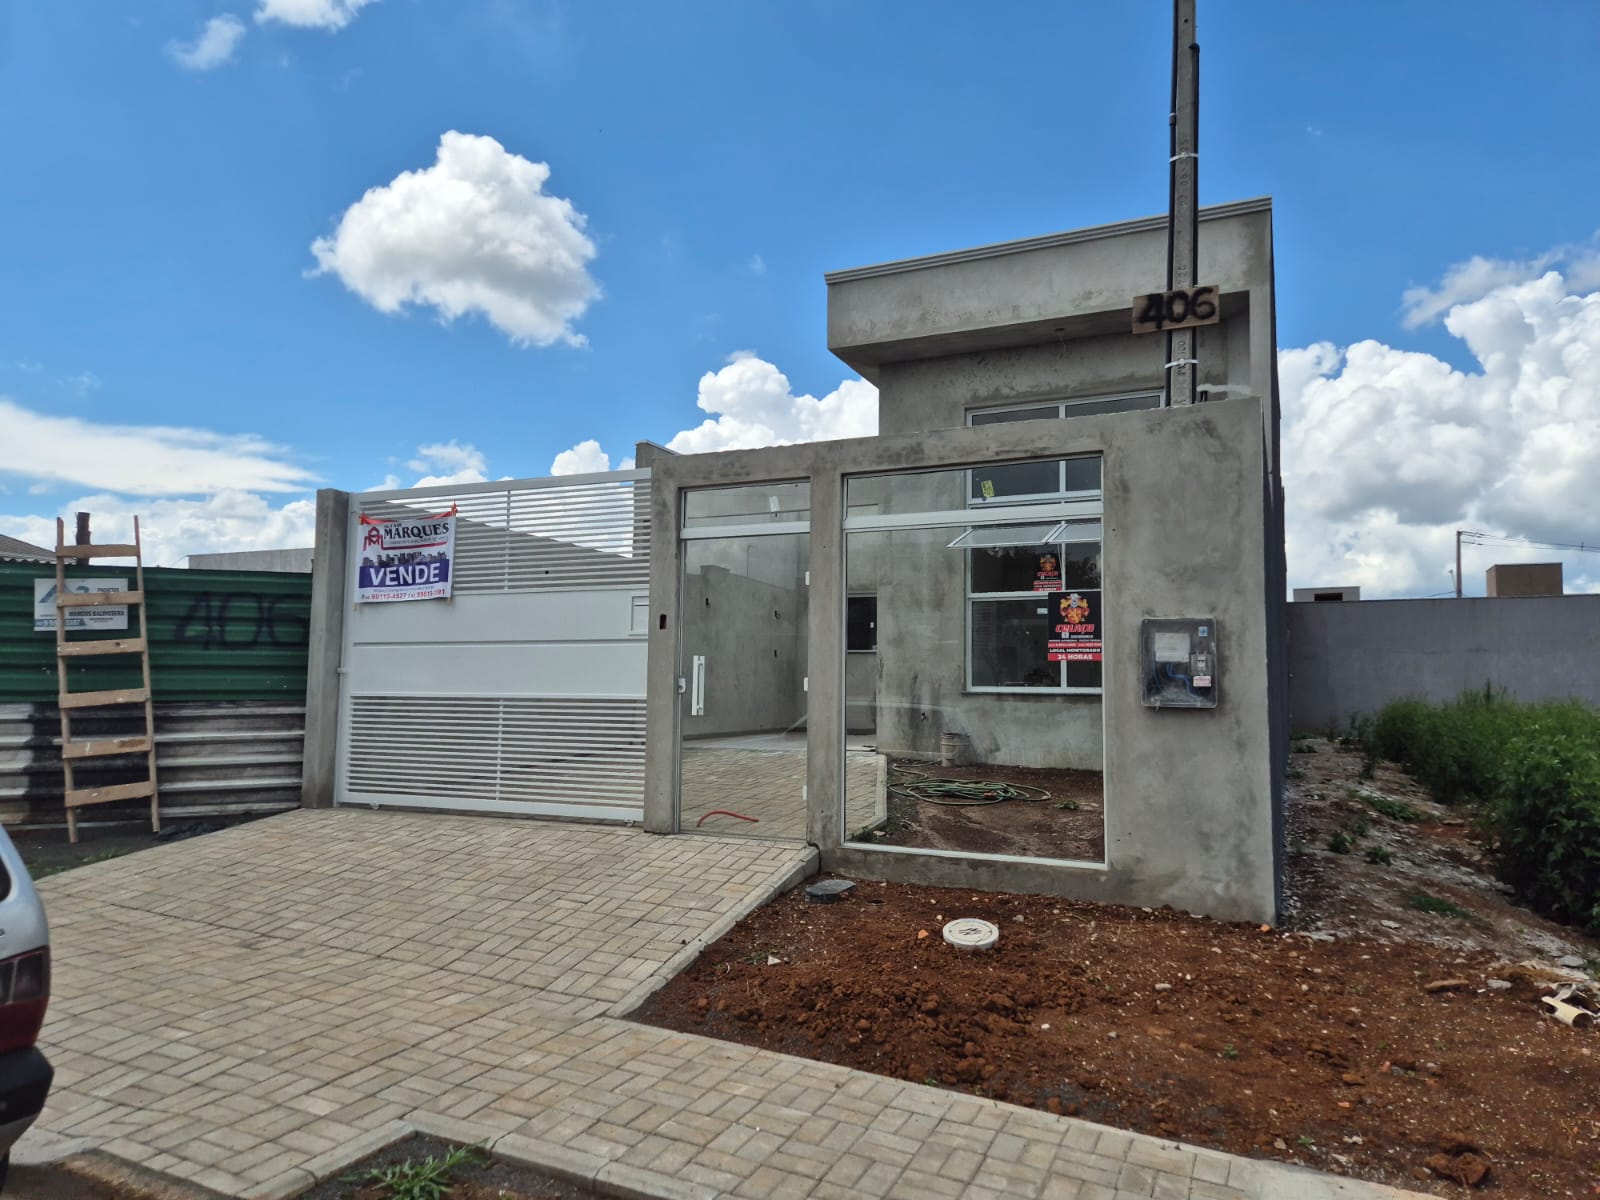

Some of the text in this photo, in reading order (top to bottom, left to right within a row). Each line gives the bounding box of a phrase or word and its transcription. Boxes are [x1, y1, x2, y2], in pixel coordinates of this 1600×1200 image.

[1138, 287, 1217, 330] 406
[384, 523, 449, 540] MARQUES
[369, 563, 440, 586] VENDE
[175, 590, 310, 650] 406
